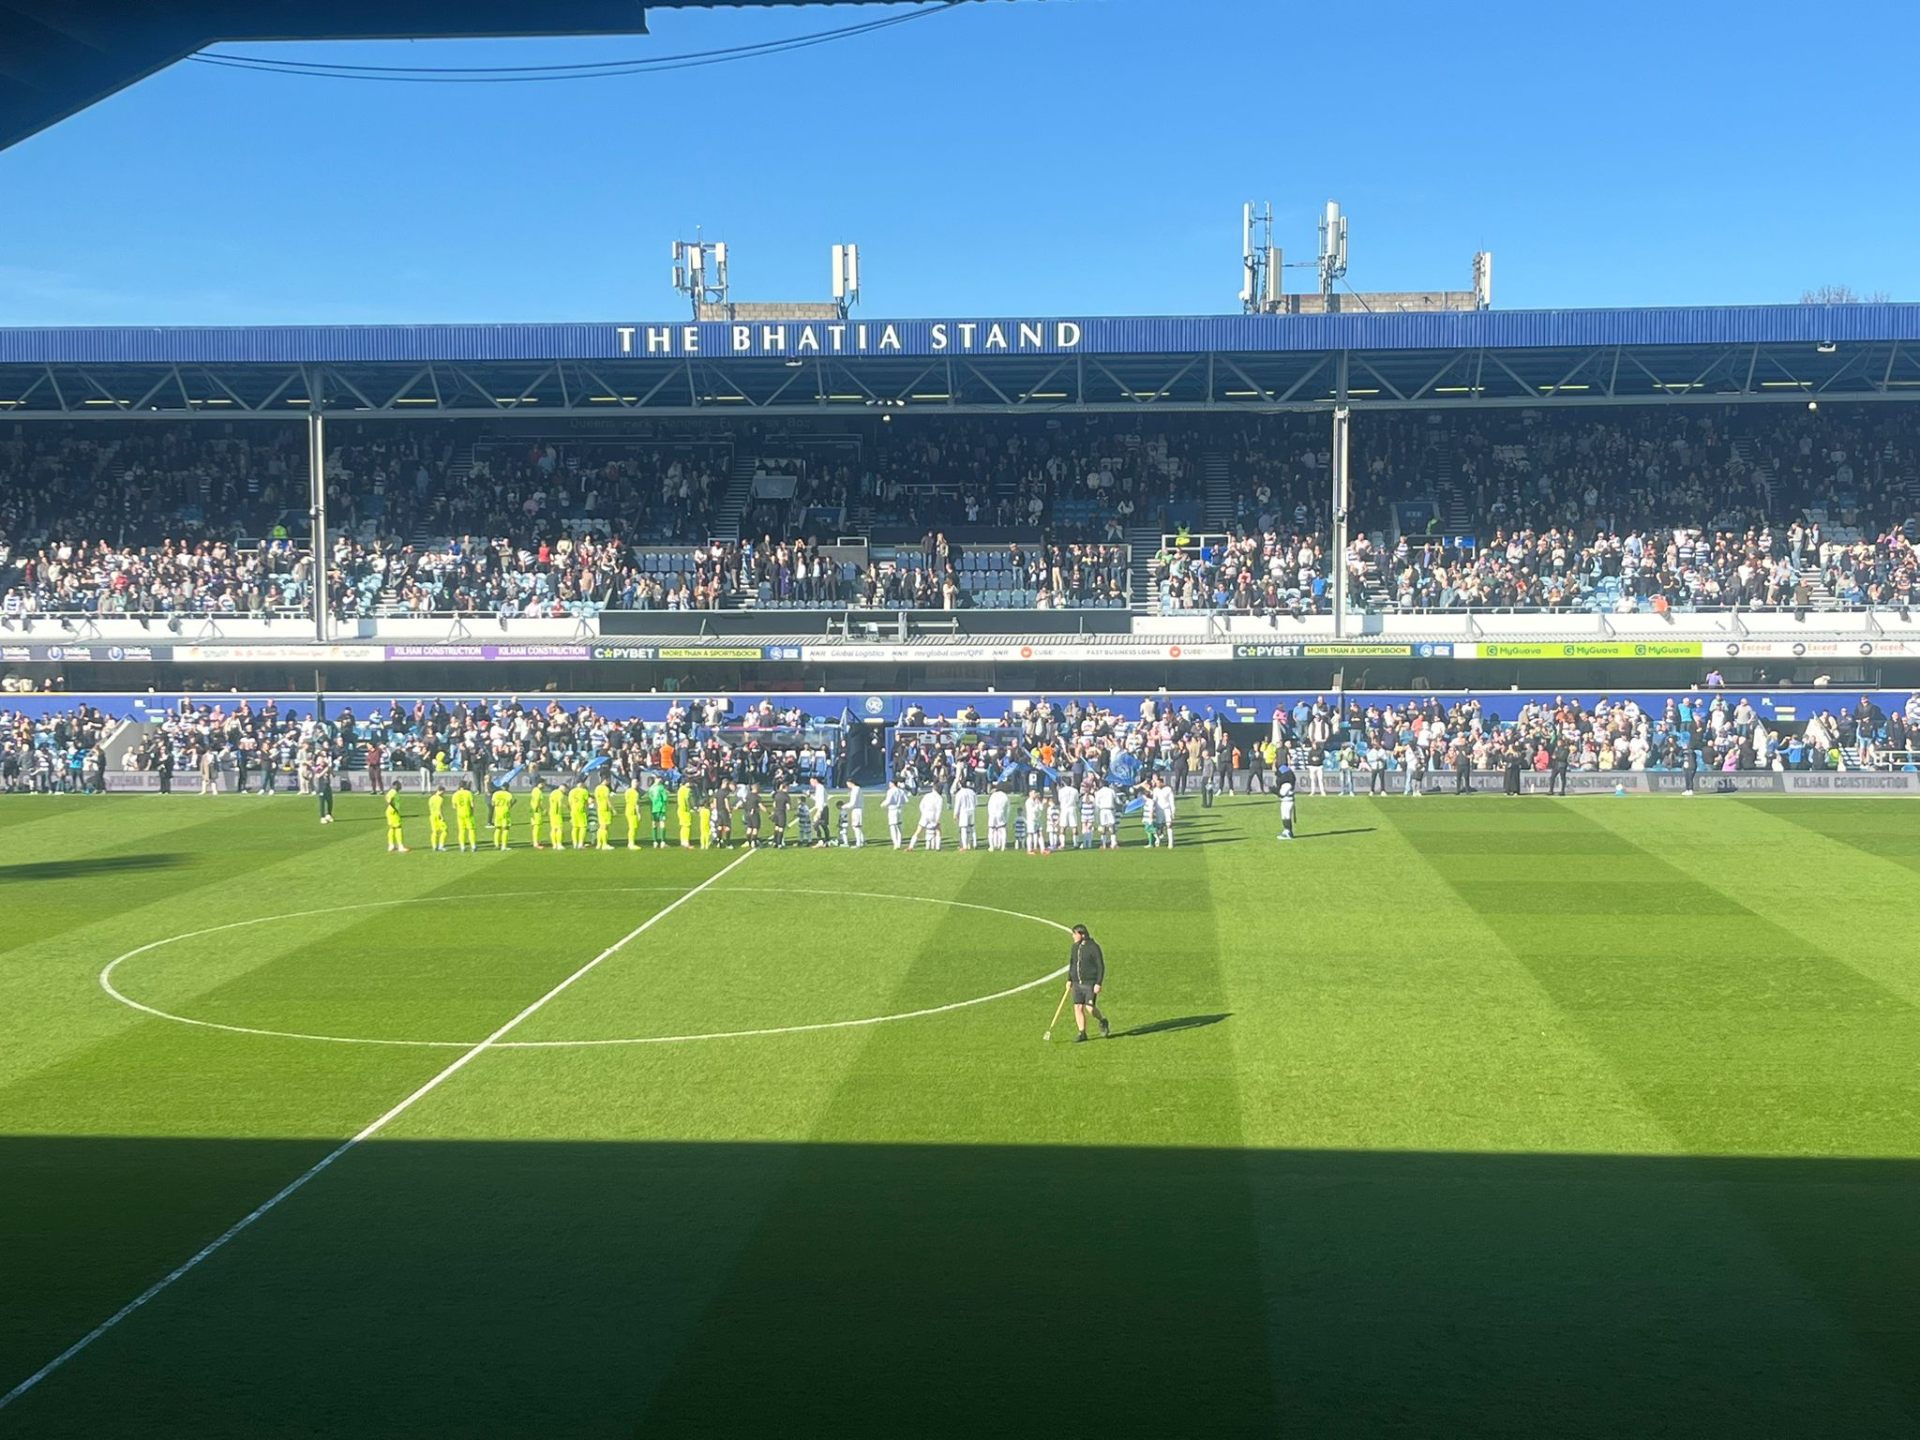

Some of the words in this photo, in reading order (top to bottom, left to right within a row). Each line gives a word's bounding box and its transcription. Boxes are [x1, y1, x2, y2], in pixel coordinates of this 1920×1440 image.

[617, 327, 700, 352] THE
[733, 324, 902, 351] BHATIA
[931, 322, 1081, 349] STAND
[1699, 776, 1774, 788] CONSTRUCTION
[1834, 777, 1909, 788] CONSTRUCTION
